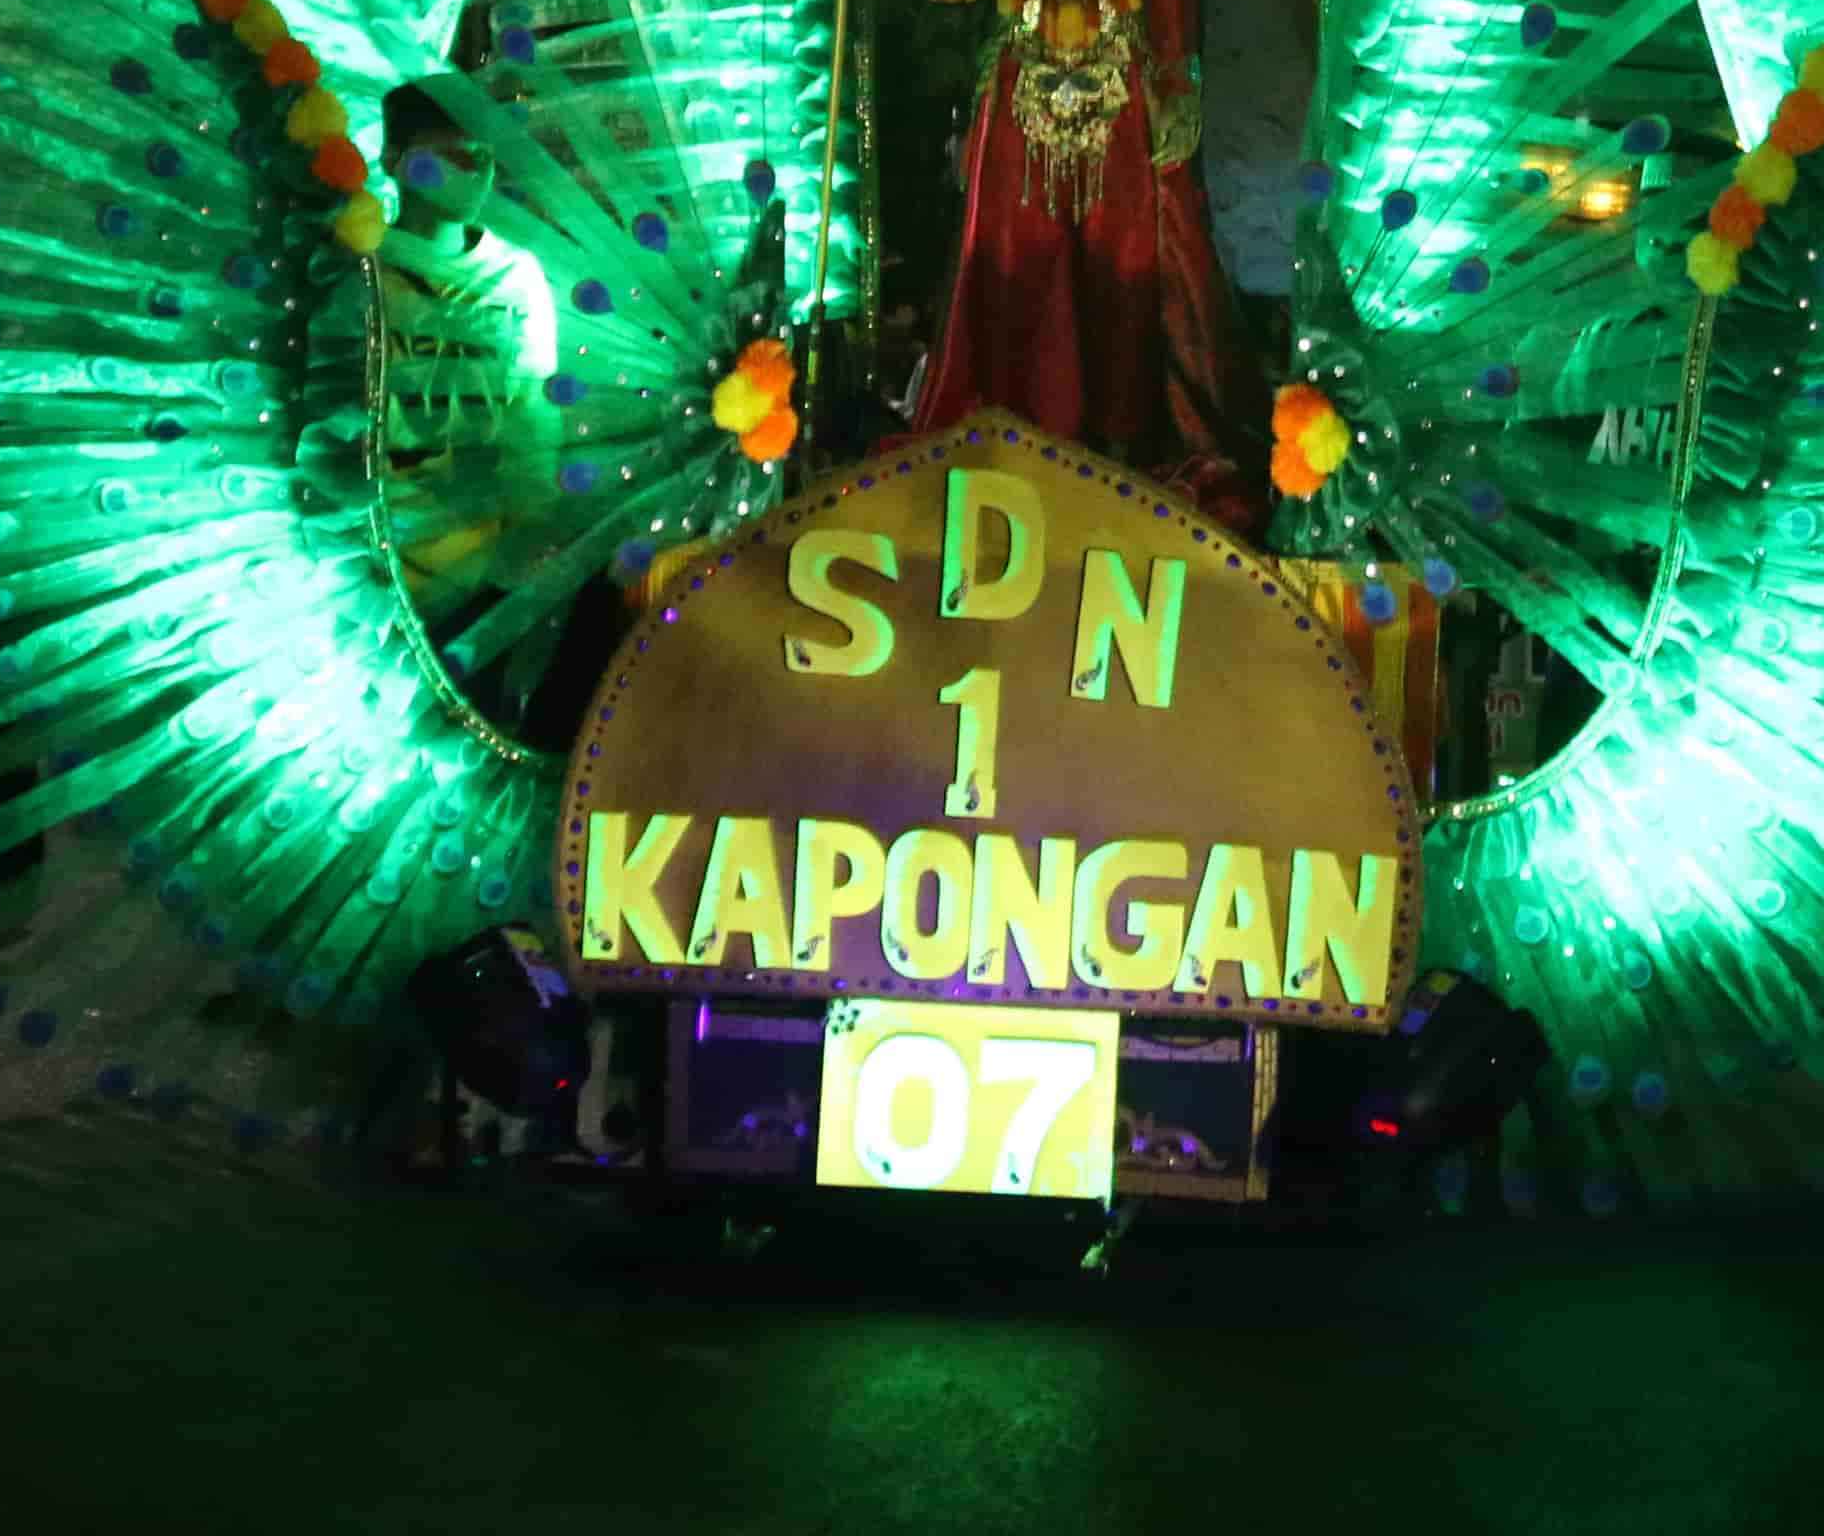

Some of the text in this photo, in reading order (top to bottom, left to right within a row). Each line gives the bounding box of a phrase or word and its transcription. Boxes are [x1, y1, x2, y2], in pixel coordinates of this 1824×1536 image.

[784, 467, 1186, 708] SDN
[938, 667, 1001, 819] 1
[581, 810, 1398, 1006] KAPONGAN
[854, 1032, 1097, 1195] 07
